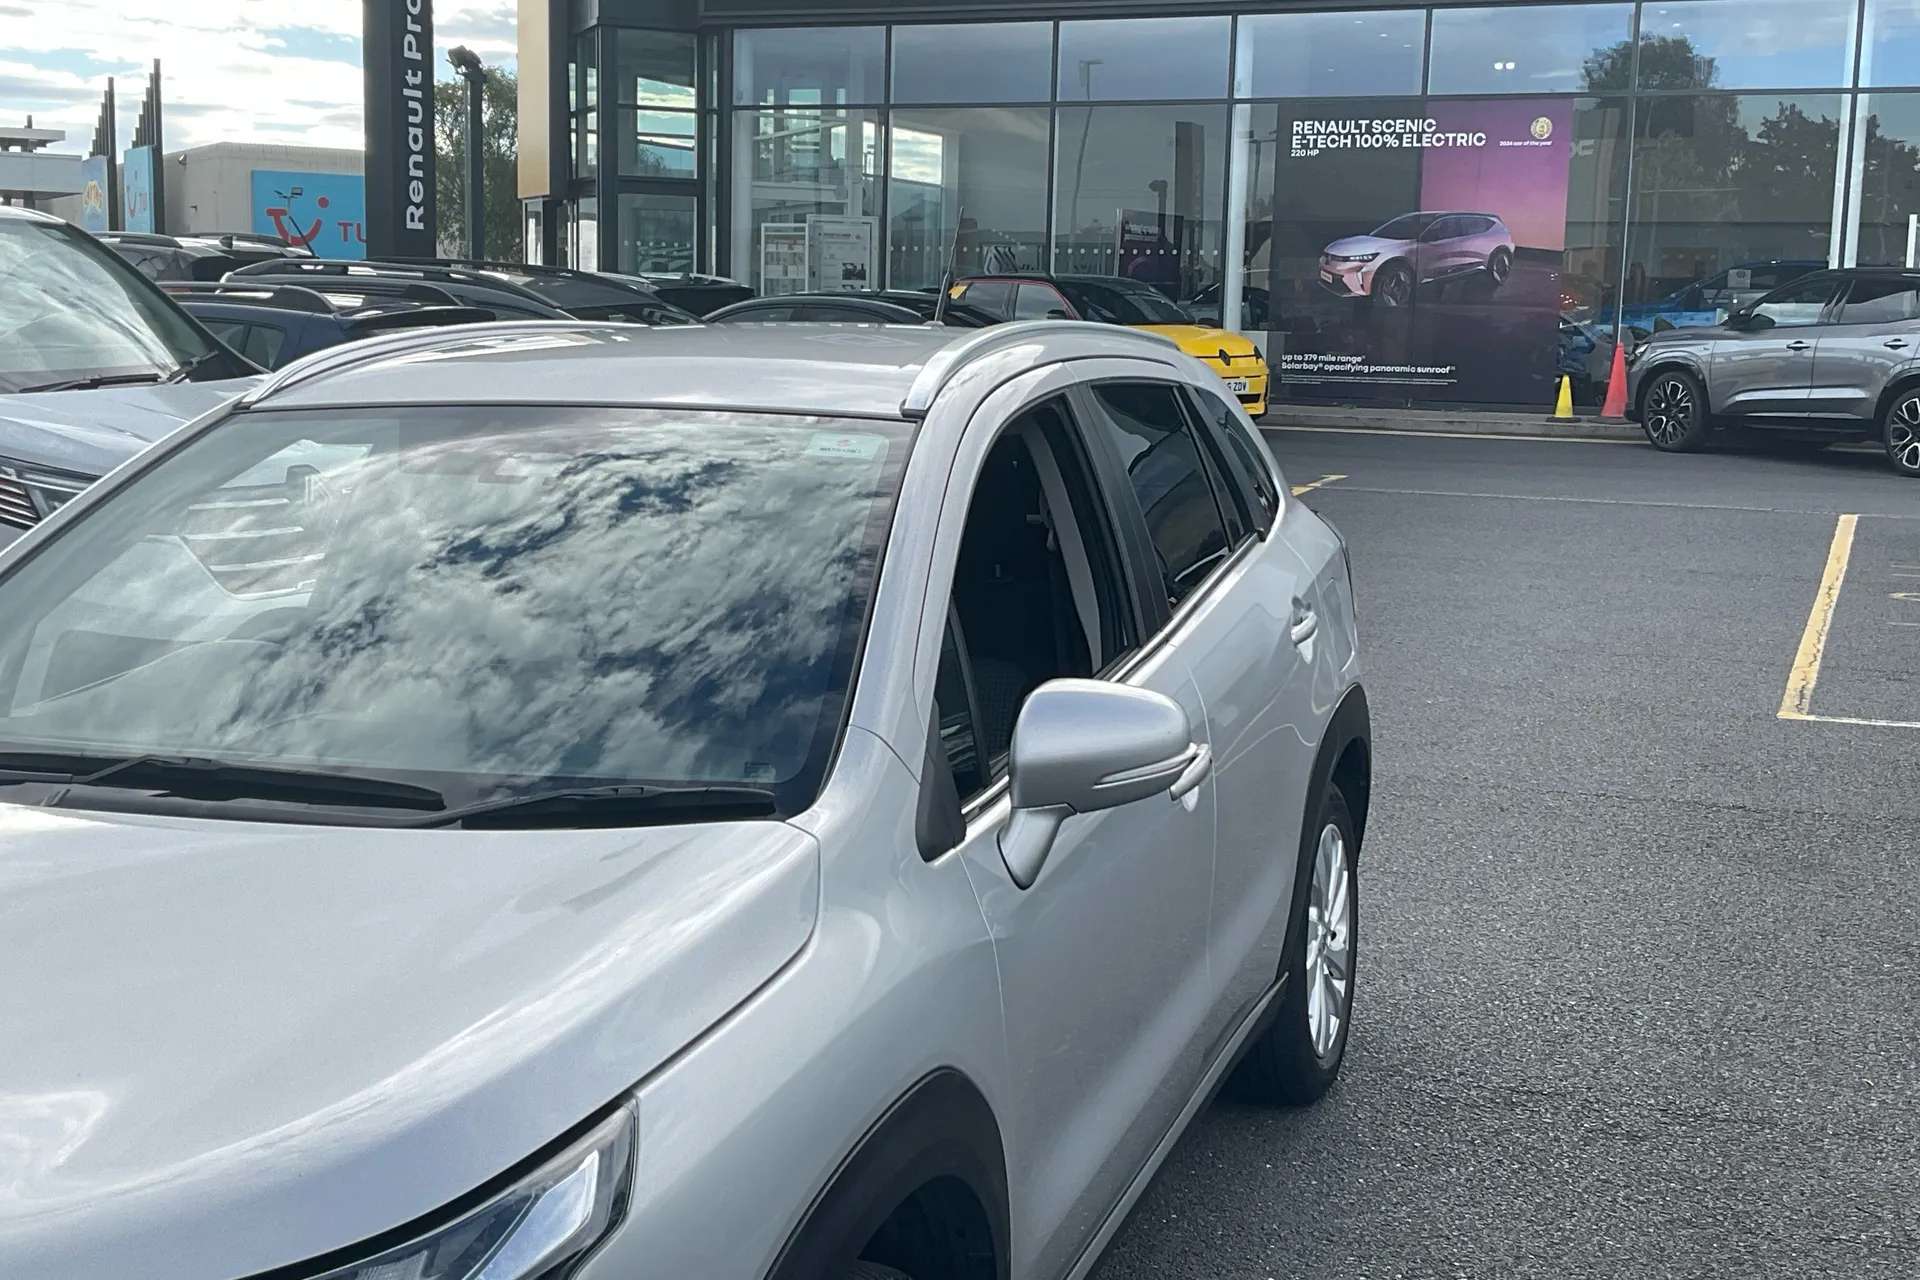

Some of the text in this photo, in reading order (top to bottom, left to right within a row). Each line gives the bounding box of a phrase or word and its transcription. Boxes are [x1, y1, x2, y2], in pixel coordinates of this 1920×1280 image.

[1293, 119, 1437, 134] RENAULT SCENIC
[1292, 132, 1487, 148] E-TECH 100% ELECTRIC
[403, 69, 424, 230] Renault
[1291, 149, 1320, 157] 220 HP
[1318, 354, 1336, 362] mile
[1324, 363, 1369, 373] opacifying
[1369, 365, 1416, 373] panoramic
[1233, 382, 1247, 391] ZDV
